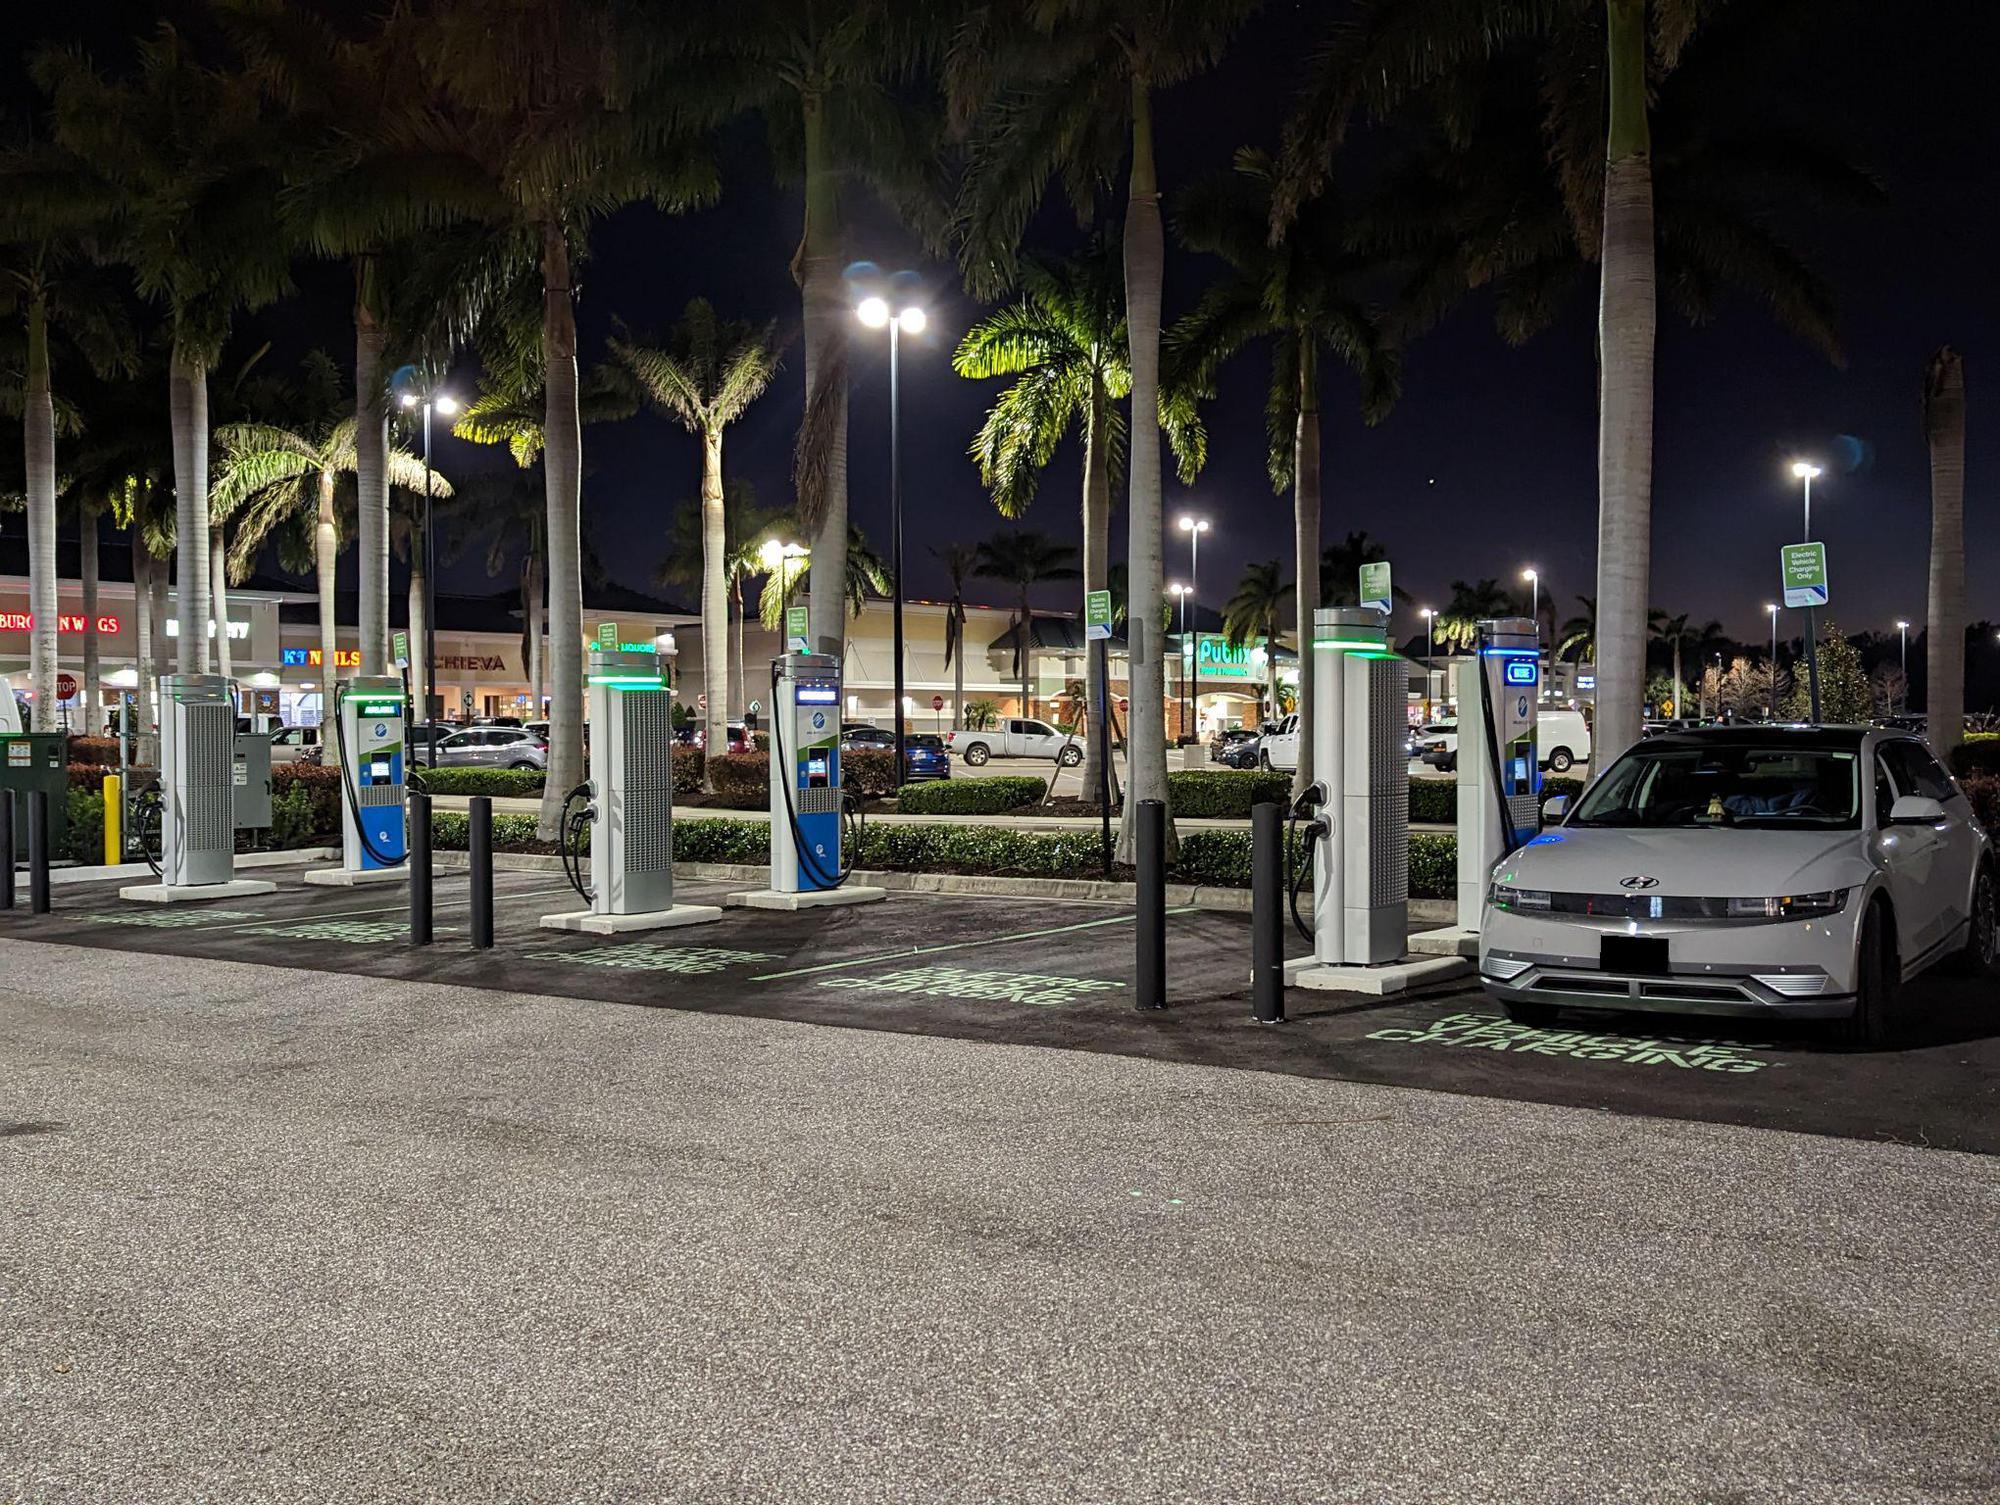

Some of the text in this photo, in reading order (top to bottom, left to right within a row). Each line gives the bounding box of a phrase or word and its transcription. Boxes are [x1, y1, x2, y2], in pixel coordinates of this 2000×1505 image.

[1791, 551, 1817, 559] Electric
[1791, 558, 1816, 566] Vehicle
[1789, 565, 1820, 573] Charging
[1797, 572, 1813, 580] Only
[72, 616, 118, 633] WGS
[309, 650, 360, 666] NILS
[1200, 640, 1250, 664] Publix
[57, 682, 76, 692] TOP
[1428, 1021, 1752, 1059] VEHICLE
[1366, 1029, 1769, 1073] CHARGING
